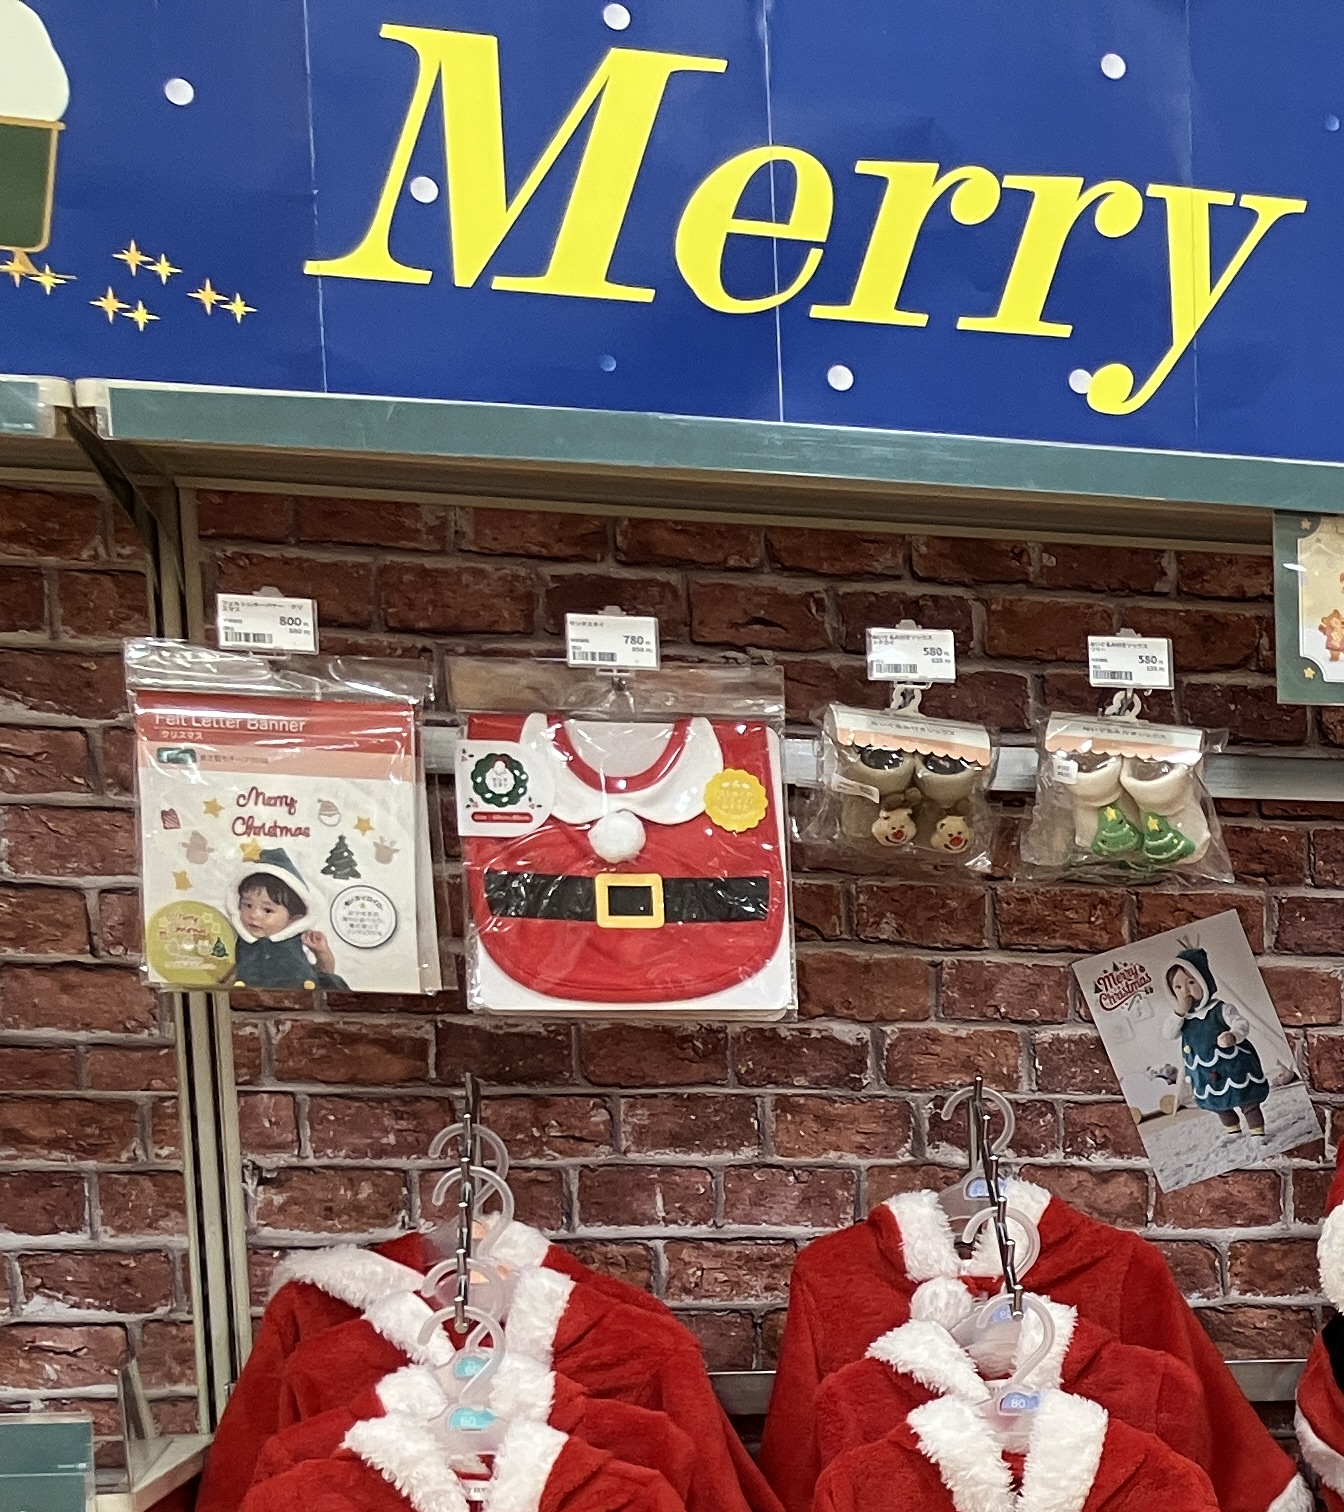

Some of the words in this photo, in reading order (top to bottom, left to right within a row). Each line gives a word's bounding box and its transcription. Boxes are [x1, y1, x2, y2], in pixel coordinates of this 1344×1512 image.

[303, 24, 1308, 417] Merry
[923, 647, 942, 656] 580
[1138, 655, 1158, 664] 580
[246, 718, 307, 732] Banner
[236, 786, 298, 815] Merry
[231, 815, 311, 838] Christmas
[1097, 964, 1139, 992] Merry
[1099, 973, 1152, 1011] Christmas
[1011, 1398, 1026, 1408] 80
